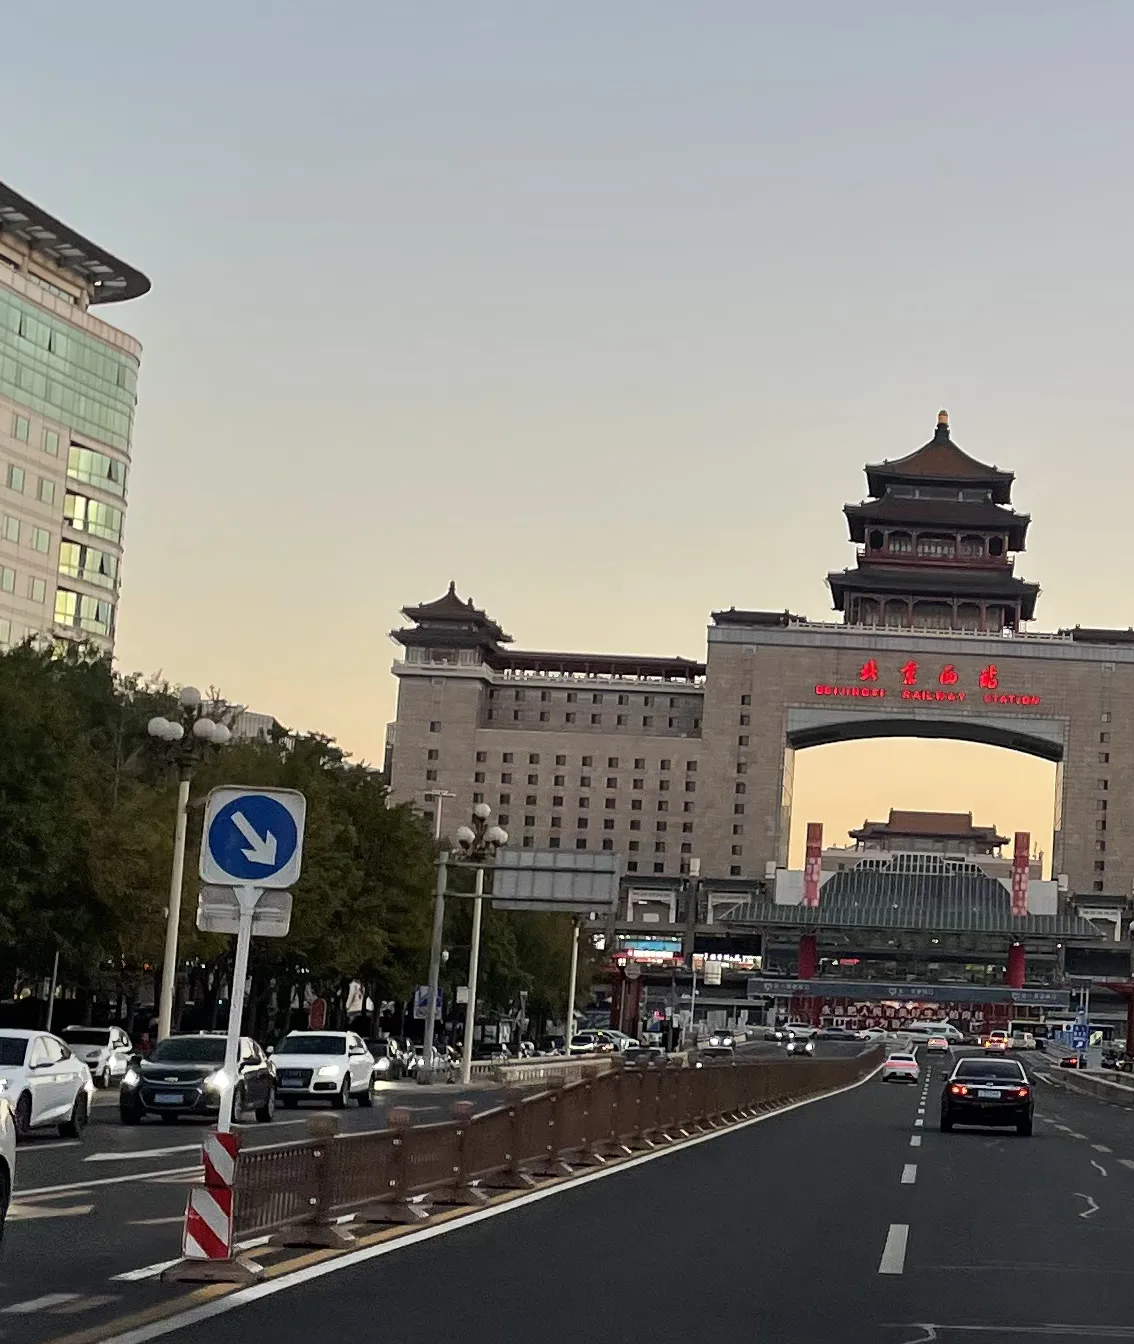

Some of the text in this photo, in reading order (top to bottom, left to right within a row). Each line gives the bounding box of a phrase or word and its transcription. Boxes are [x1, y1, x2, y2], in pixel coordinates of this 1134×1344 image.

[860, 658, 998, 689] 北京西站
[902, 689, 966, 702] RAILWAY
[984, 693, 1040, 706] STATION
